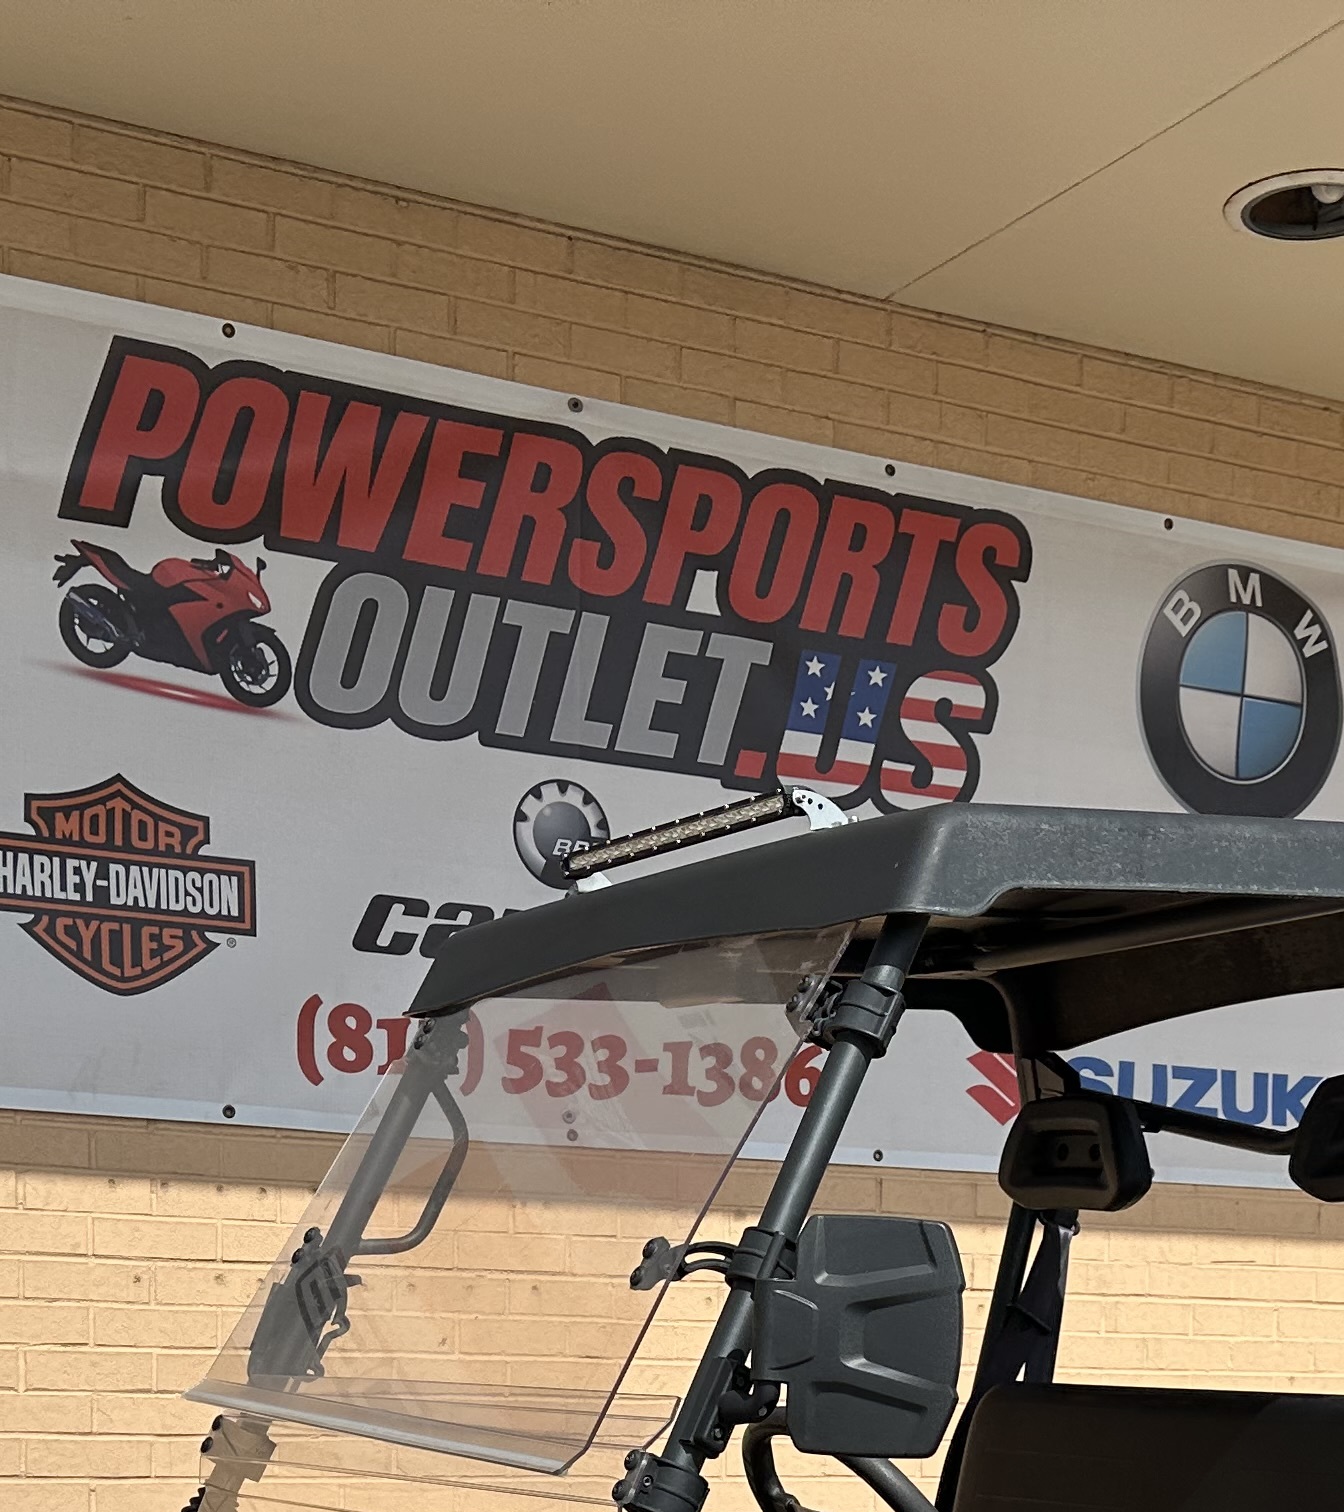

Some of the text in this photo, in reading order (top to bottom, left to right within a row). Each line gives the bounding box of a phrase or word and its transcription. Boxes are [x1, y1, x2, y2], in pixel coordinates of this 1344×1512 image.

[64, 346, 1027, 662] POWERSPORTS
[1162, 568, 1329, 660] BMW
[301, 567, 991, 804] OUTLET.US
[55, 797, 182, 853] MOTOR
[55, 916, 185, 977] CYCLES
[296, 994, 827, 1107] (81) 533-1386
[1066, 1056, 1326, 1127] SUZUK
